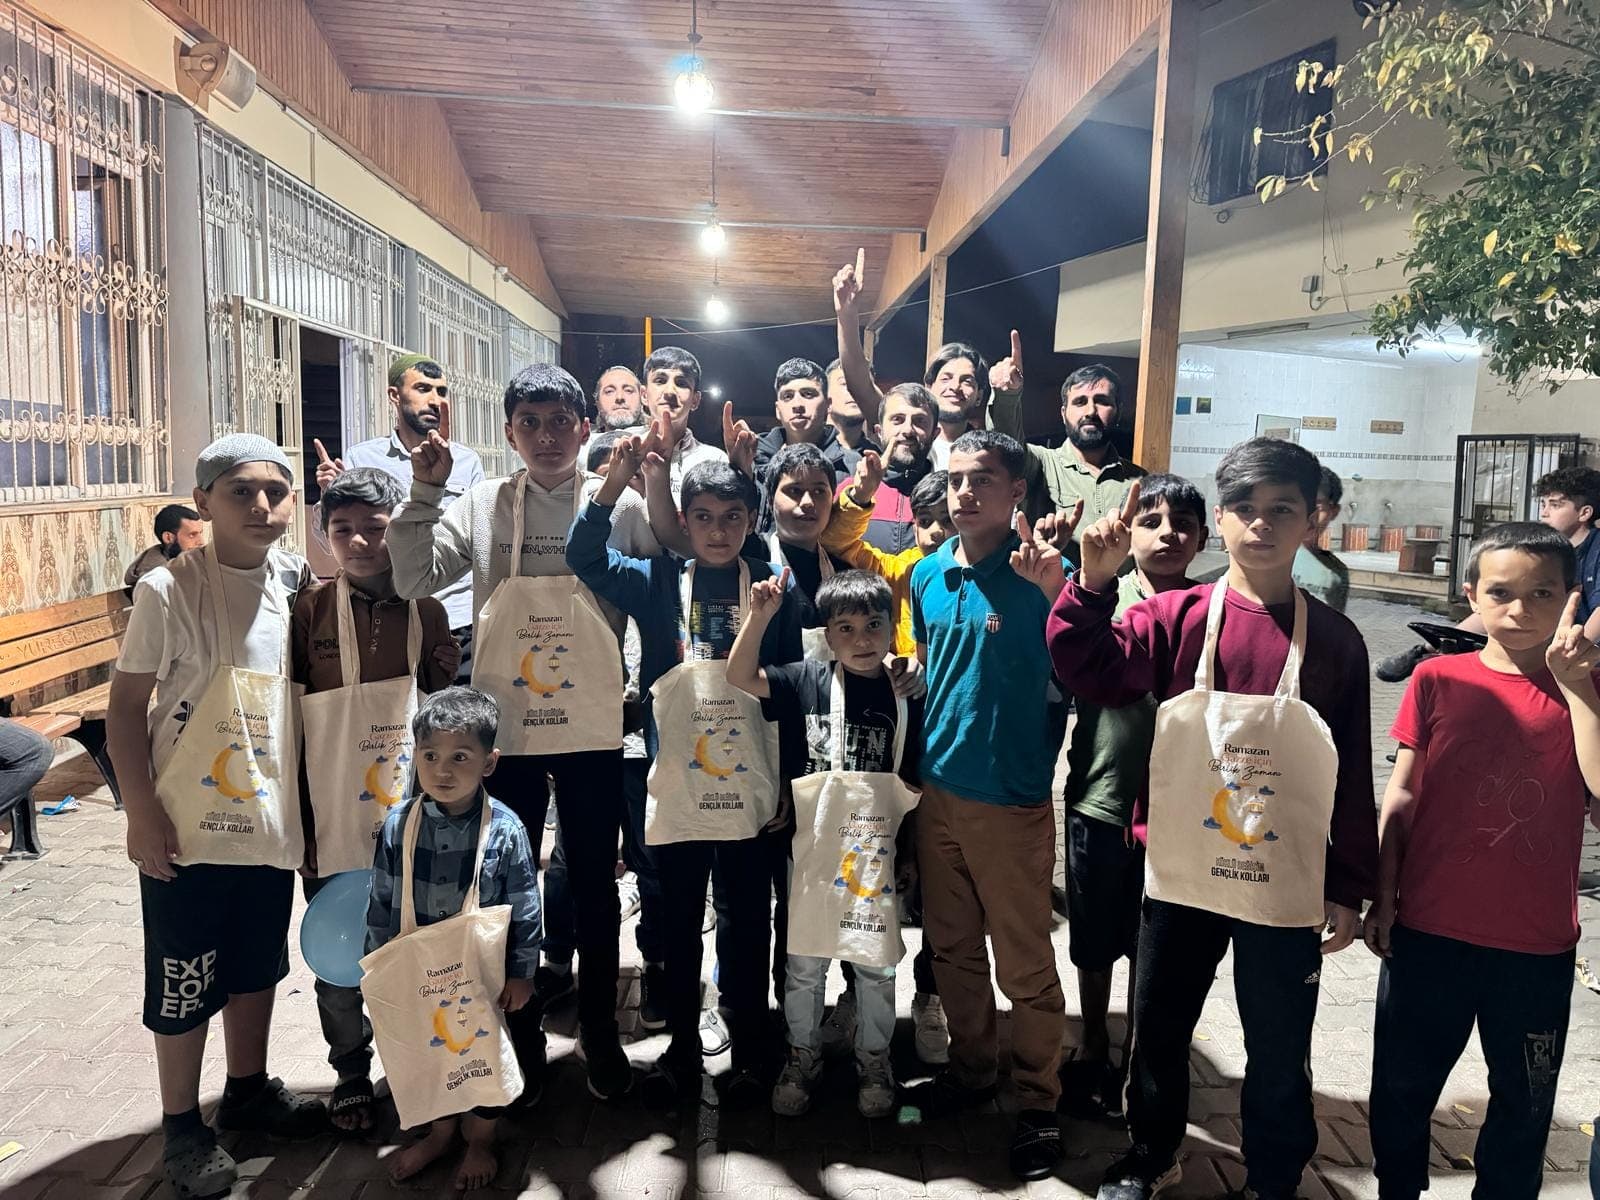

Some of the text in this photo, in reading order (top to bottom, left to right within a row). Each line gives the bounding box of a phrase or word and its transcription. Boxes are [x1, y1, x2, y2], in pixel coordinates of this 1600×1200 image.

[529, 615, 562, 623] Ramazan
[702, 698, 735, 706] Ramazan
[371, 724, 407, 733] Ramazan
[1224, 743, 1270, 756] Ramazan
[850, 812, 885, 822] Ramazan
[1211, 866, 1270, 882] GENÇLİK KOLLARI
[163, 949, 217, 979] EXP
[427, 961, 464, 978] Ramazan
